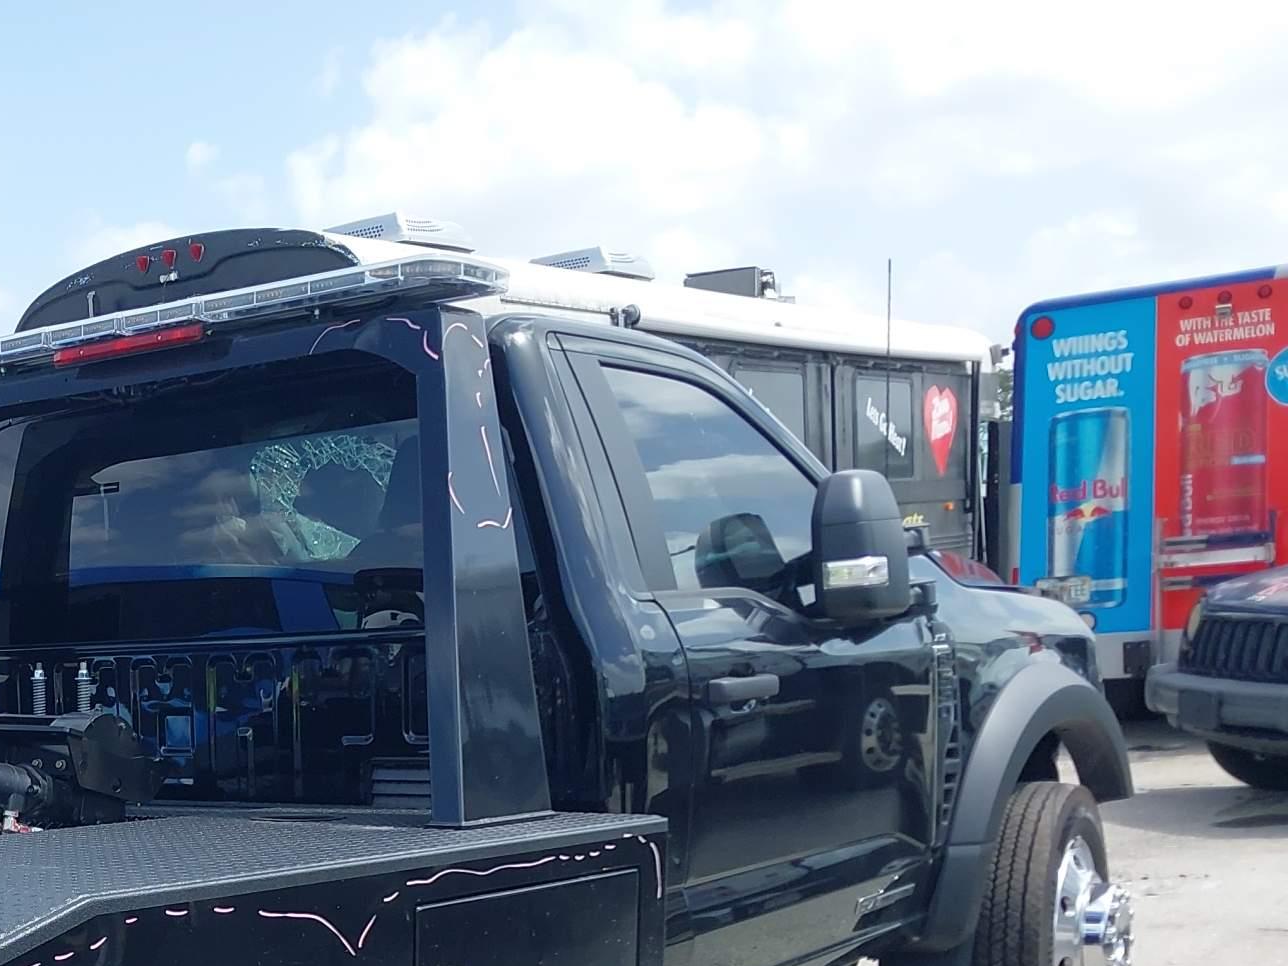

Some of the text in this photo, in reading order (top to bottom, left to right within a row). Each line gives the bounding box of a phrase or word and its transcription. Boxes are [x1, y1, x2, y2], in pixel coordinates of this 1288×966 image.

[1180, 308, 1272, 333] WITH THE TASTE
[1176, 323, 1275, 347] OF WATERMELON
[1047, 353, 1134, 382] WITHOUT
[1055, 377, 1125, 404] SUGAR.
